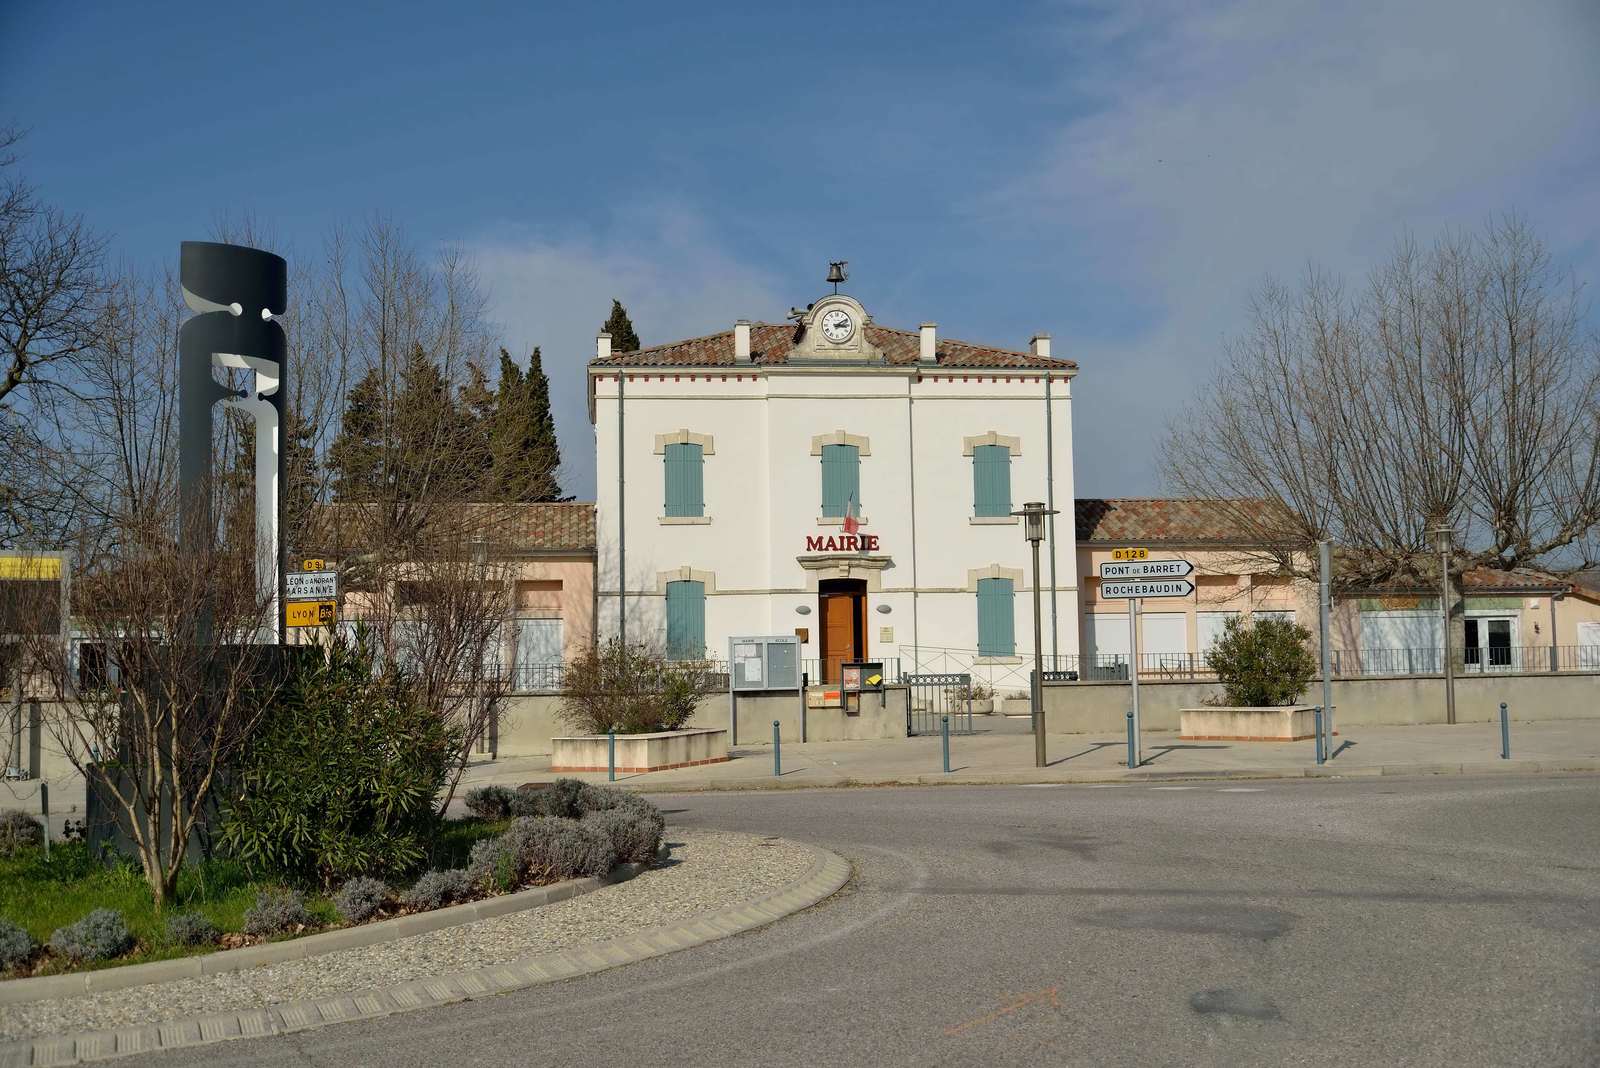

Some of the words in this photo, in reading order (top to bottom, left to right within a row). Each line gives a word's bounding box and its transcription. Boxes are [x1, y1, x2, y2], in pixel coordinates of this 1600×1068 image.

[806, 535, 880, 552] MAIRIE
[1115, 550, 1122, 559] D
[1125, 550, 1145, 558] 128
[307, 561, 313, 569] D
[1105, 566, 1130, 575] PONT
[1143, 564, 1182, 574] BARRET
[286, 575, 304, 586] LÉON
[1105, 584, 1182, 595] ROCHEBAUDIN
[292, 610, 314, 619] LYON
